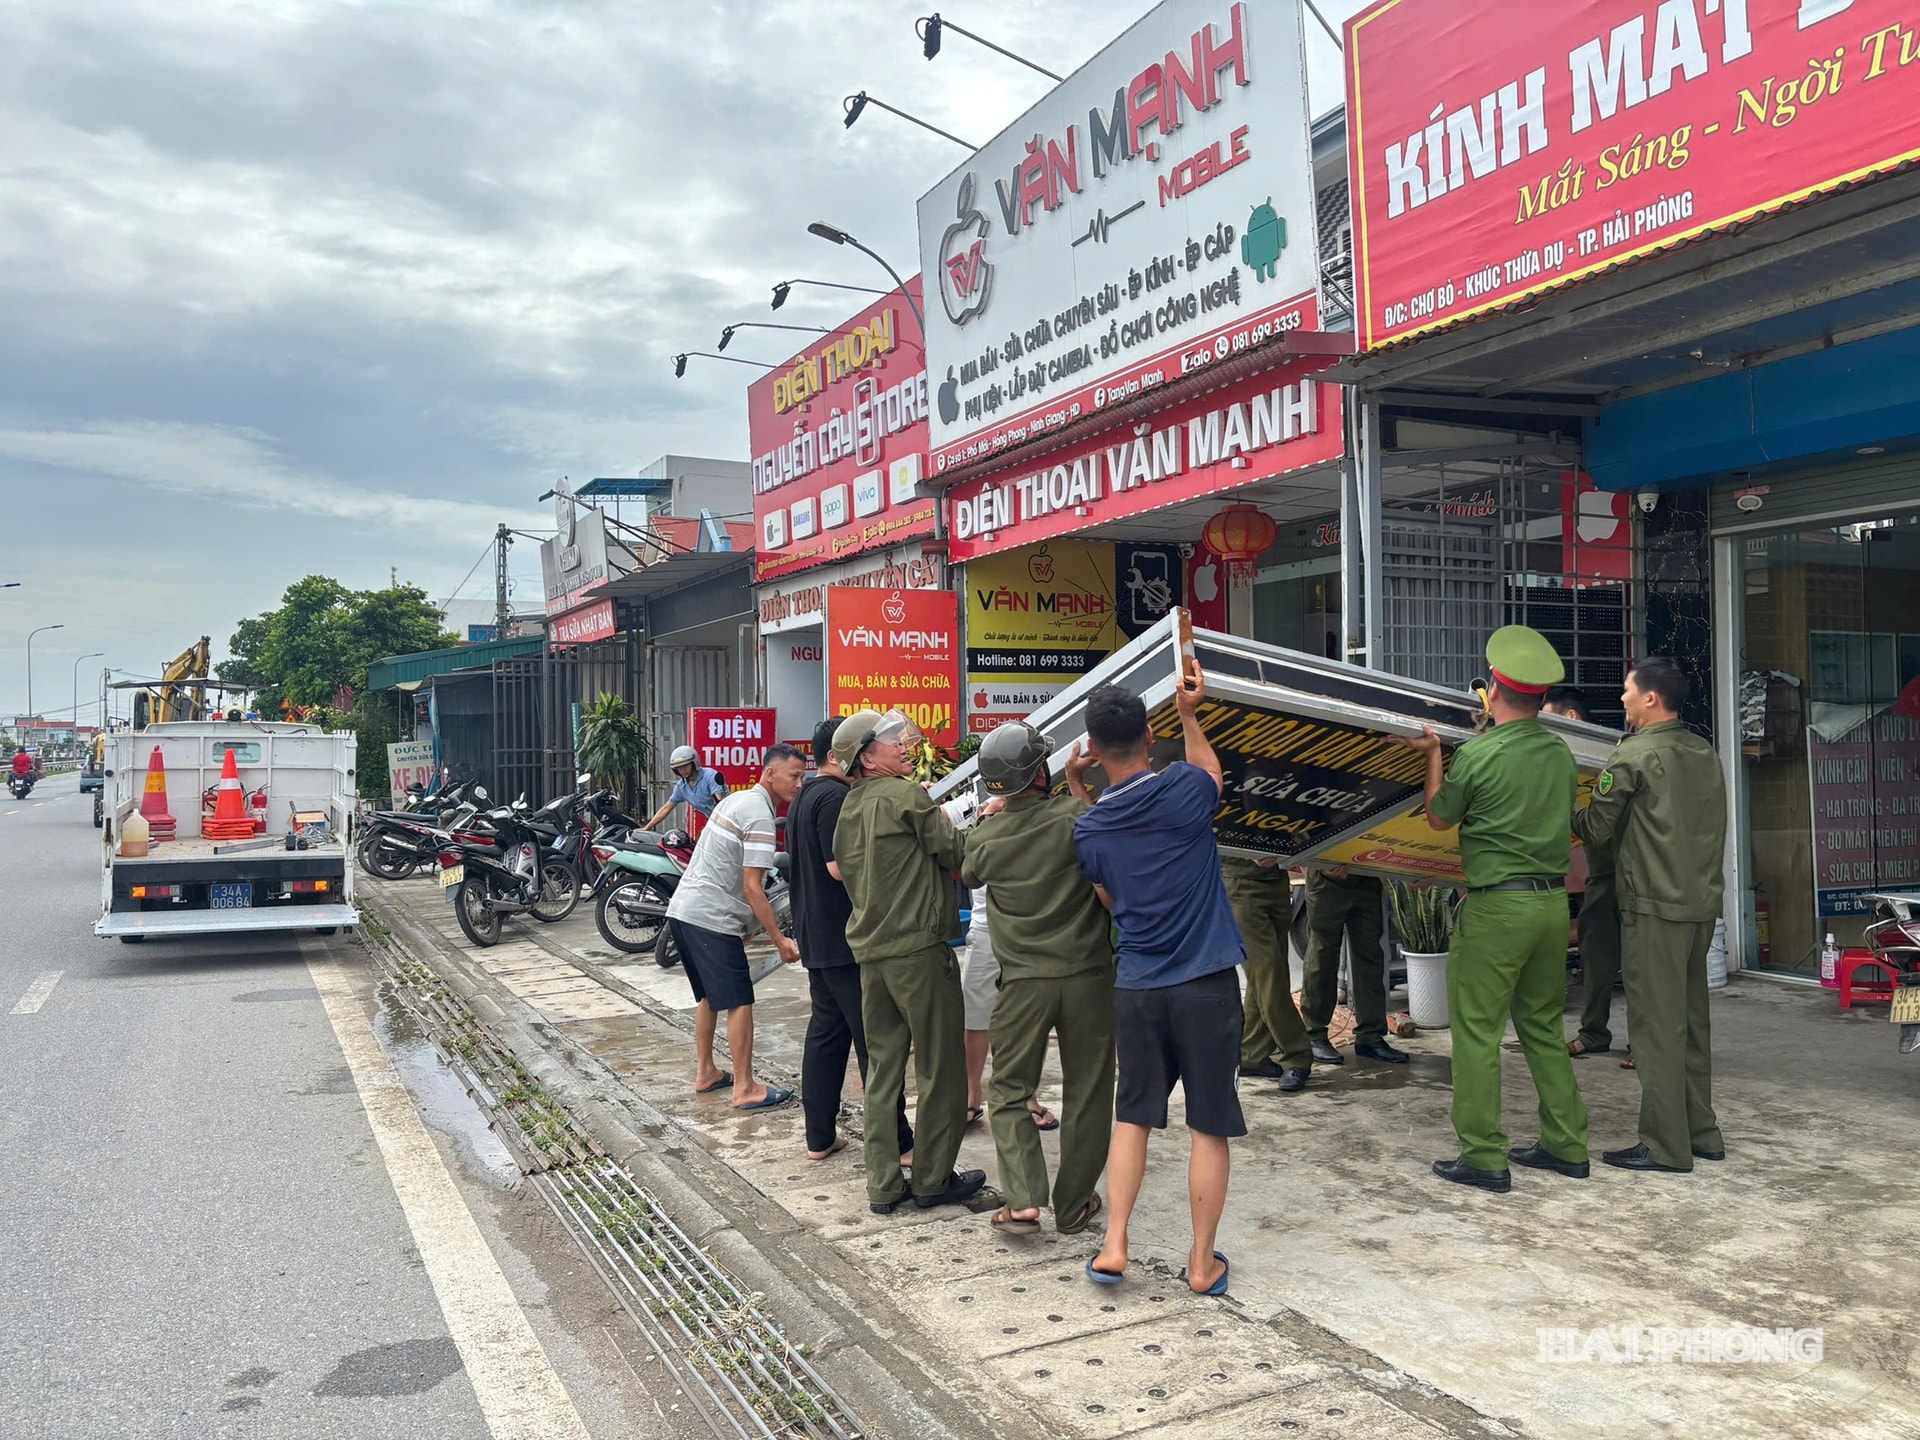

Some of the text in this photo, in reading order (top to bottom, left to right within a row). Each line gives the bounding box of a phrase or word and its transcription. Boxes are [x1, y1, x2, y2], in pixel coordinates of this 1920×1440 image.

[994, 2, 1251, 236] VĂN MẠNH
[1384, 65, 1548, 220] KÍNH
[1515, 157, 1583, 225] Mắt
[1596, 122, 1692, 192] Sáng
[1733, 47, 1846, 134] Ngời
[1158, 124, 1251, 207] MOBILE
[1384, 305, 1409, 329] Đ/C:
[1410, 286, 1435, 318] CHỢ
[1465, 263, 1501, 300] KHÚC
[1504, 249, 1540, 284] THỪA
[1544, 240, 1564, 271] DỤ
[1578, 228, 1599, 257] TP.
[1602, 210, 1630, 247] HẢI
[1634, 190, 1693, 237] PHÒNG
[960, 360, 979, 386] MUA
[980, 345, 999, 376] BÁN
[1004, 332, 1024, 363] SỬA
[1024, 319, 1053, 353] CHỮA
[1054, 295, 1097, 337] CHUYÊN
[1097, 283, 1120, 315] SÂU
[1145, 255, 1176, 292] KÍNH
[965, 395, 982, 421] PHỤ
[983, 383, 1003, 414] KIỆN
[1008, 366, 1027, 400] LẮP
[1048, 344, 1093, 382] CAMERA
[1101, 319, 1119, 359] ĐỒ
[1121, 310, 1154, 349] CHƠI
[1156, 293, 1198, 333] CÔNG
[1200, 266, 1241, 313] NGHỆ
[1181, 310, 1301, 373] Zalo 081 699 3333
[773, 308, 895, 414] ĐIỆN THOẠI
[957, 379, 1316, 541] ĐIỆN THOẠI VĂN MẠNH
[857, 487, 875, 502] vivo
[761, 590, 791, 627] ĐIỆN
[792, 578, 834, 617] THO
[977, 585, 1105, 616] VĂN MẠNH
[838, 626, 948, 651] VĂN MẠNH
[1075, 621, 1105, 629] MOBILE
[977, 654, 1085, 667] Hotline: 081 699 3333
[838, 671, 951, 690] MUA, BÁN & SỬA CHỮA
[992, 694, 1012, 704] MUA
[1013, 691, 1030, 704] BÁN
[708, 715, 762, 743] ĐIỆN
[1212, 711, 1314, 764] THOẠI
[702, 746, 768, 771] THOẠI
[1817, 755, 1843, 784] KÍNH
[1846, 754, 1868, 788] CẬN
[1233, 773, 1299, 800] SỬA
[1295, 786, 1376, 814] CHỮA
[1826, 799, 1844, 818] HAI
[1892, 798, 1906, 816] ĐA
[1234, 810, 1327, 834] NGAY
[1828, 831, 1842, 850] ĐO
[1901, 826, 1918, 847] PHÍ
[1829, 858, 1850, 883] SỬA
[212, 896, 250, 909] 006.84
[221, 885, 242, 897] 34A
